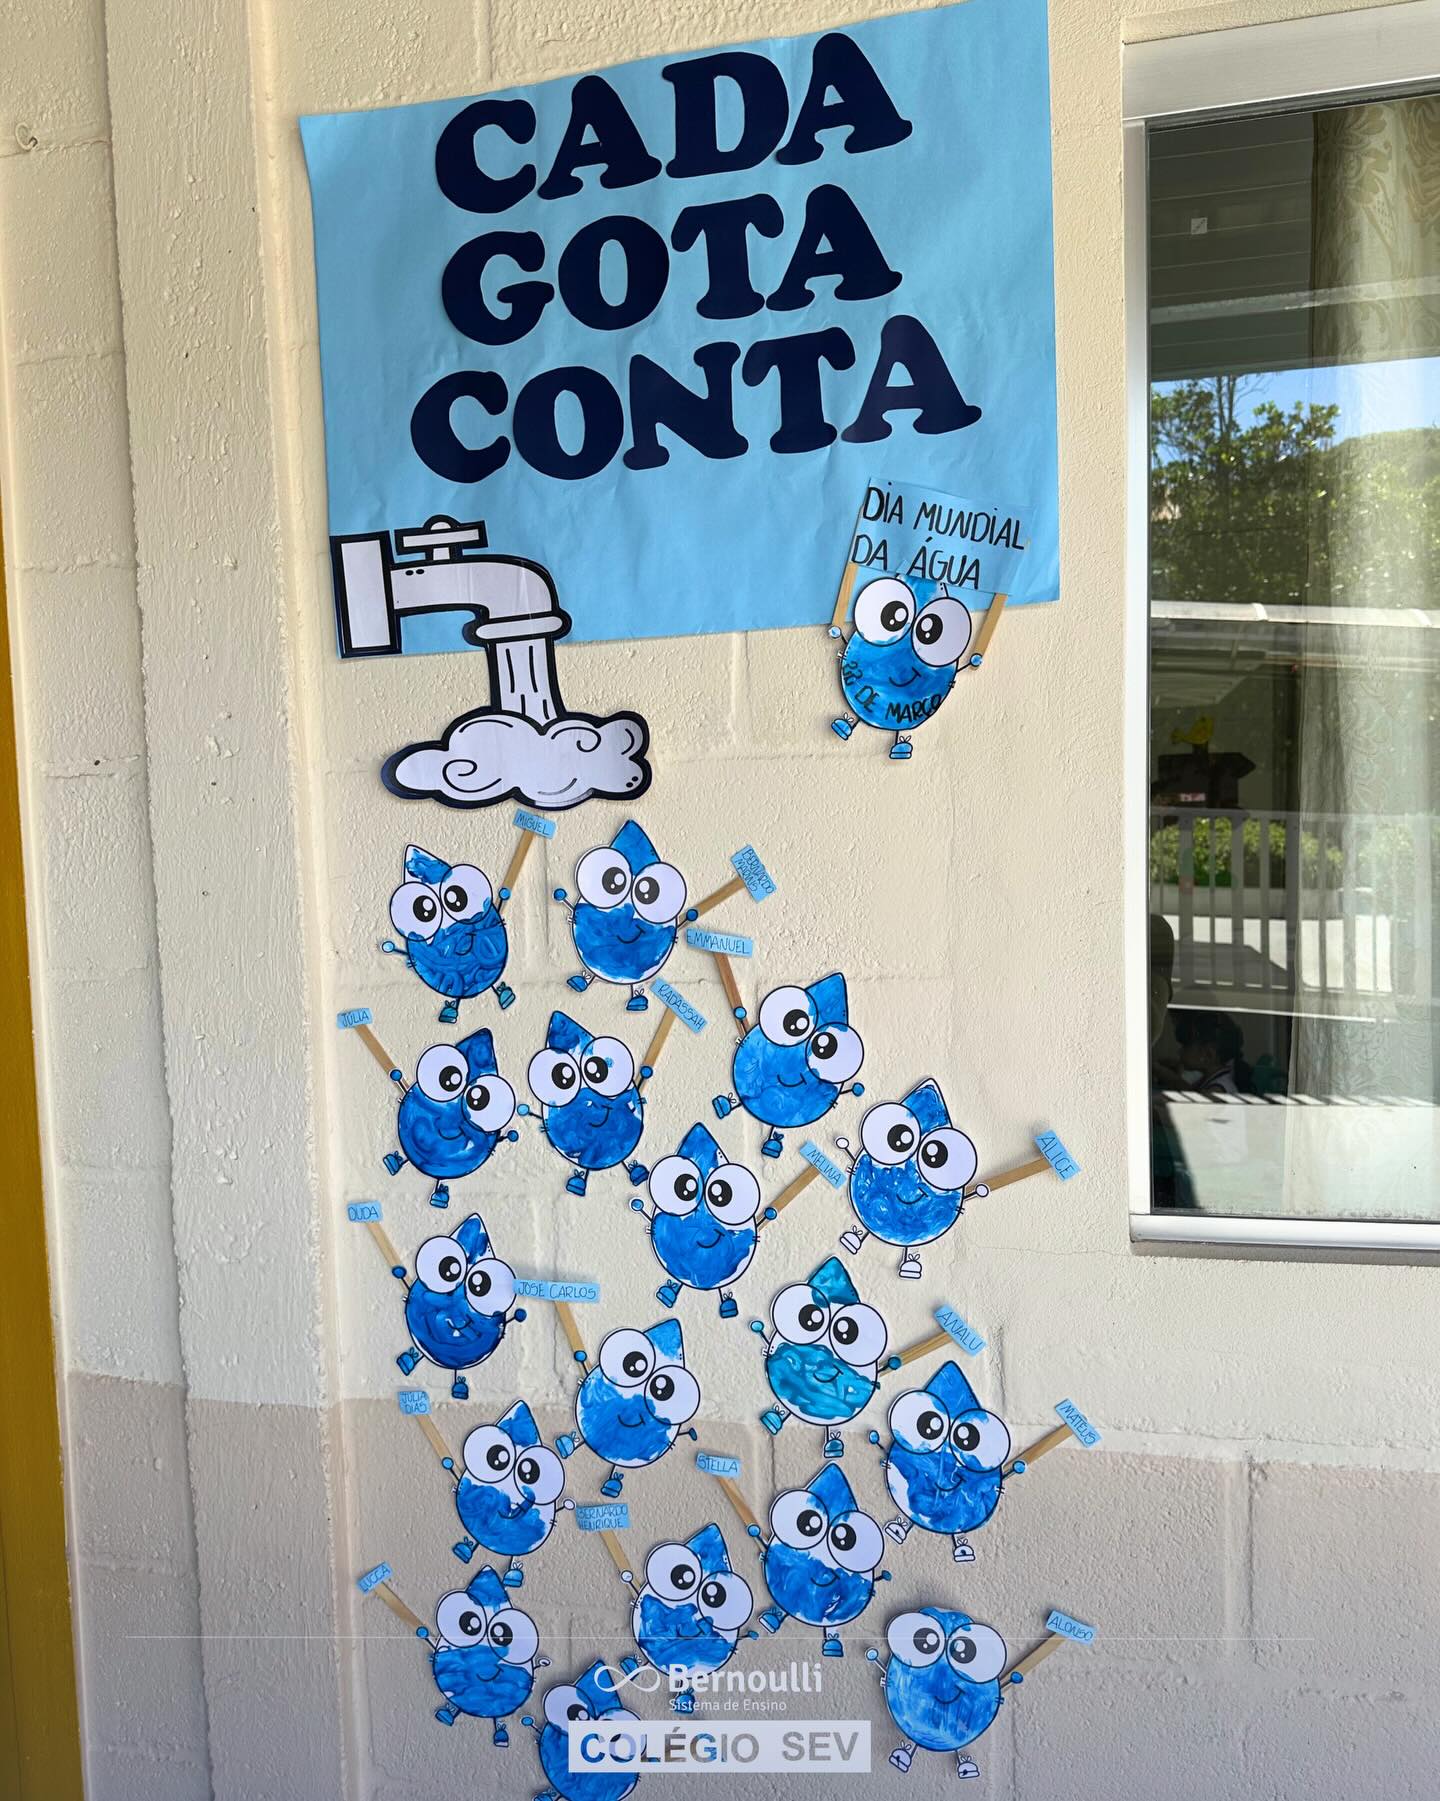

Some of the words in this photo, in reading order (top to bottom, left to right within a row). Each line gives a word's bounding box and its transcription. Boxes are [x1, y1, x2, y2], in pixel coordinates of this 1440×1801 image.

[435, 32, 913, 213] CADA
[441, 183, 903, 346] GOTA
[410, 315, 982, 484] CONTA
[913, 502, 1025, 550] MUNDIAL
[851, 534, 887, 571] DA
[906, 536, 980, 590] ÁGUA
[855, 686, 880, 713] DE
[517, 813, 549, 836] MIGUEL
[686, 930, 750, 955] EMMANUEL
[807, 1149, 842, 1185] MELINA
[1037, 1137, 1075, 1179] ALICE
[347, 1206, 379, 1221] DUDA
[549, 1283, 597, 1300] CARLOS
[1060, 1404, 1096, 1445] MATEUS
[697, 1454, 738, 1473] STELLA
